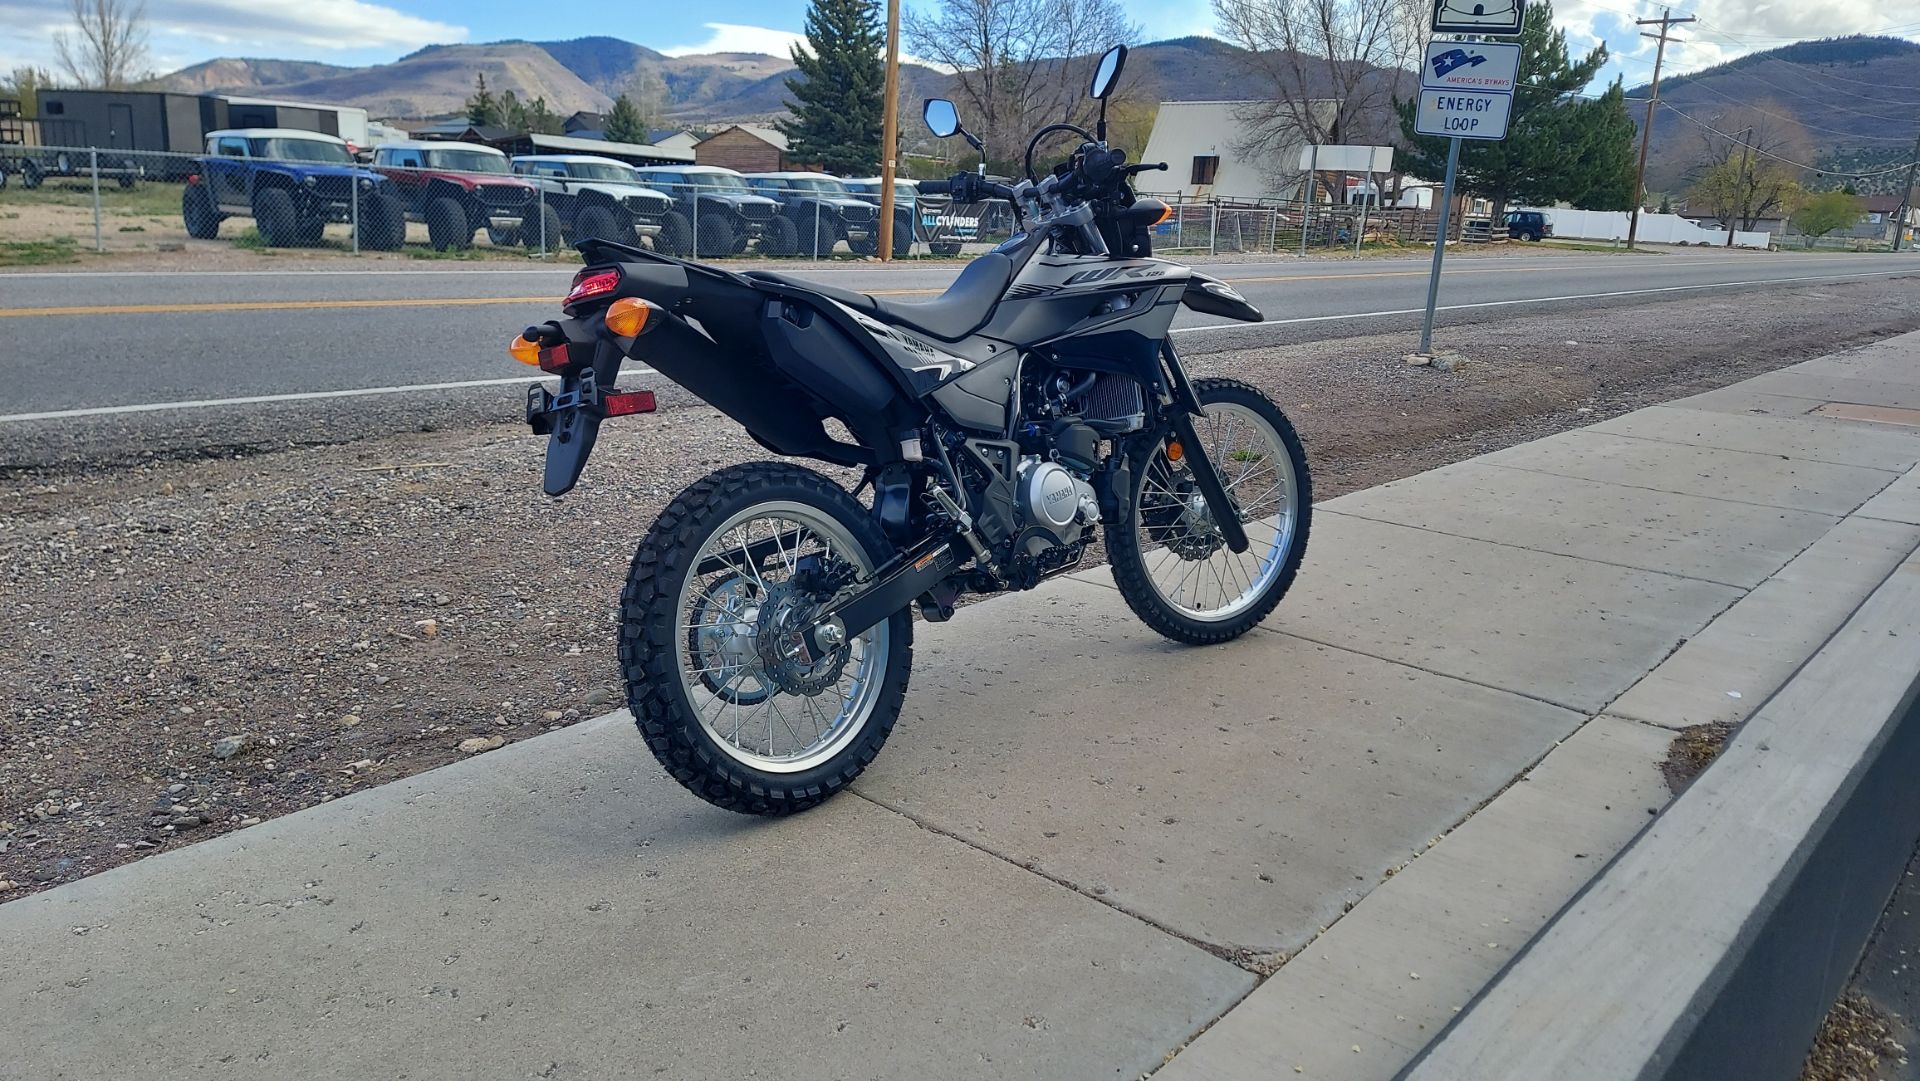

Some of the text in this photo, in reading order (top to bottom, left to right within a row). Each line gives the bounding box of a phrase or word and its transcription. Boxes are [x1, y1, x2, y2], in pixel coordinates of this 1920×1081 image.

[1446, 76, 1510, 86] AMERICA'S BYWAYS
[1437, 96, 1492, 112] ENERGY
[1444, 117, 1479, 131] LOOP
